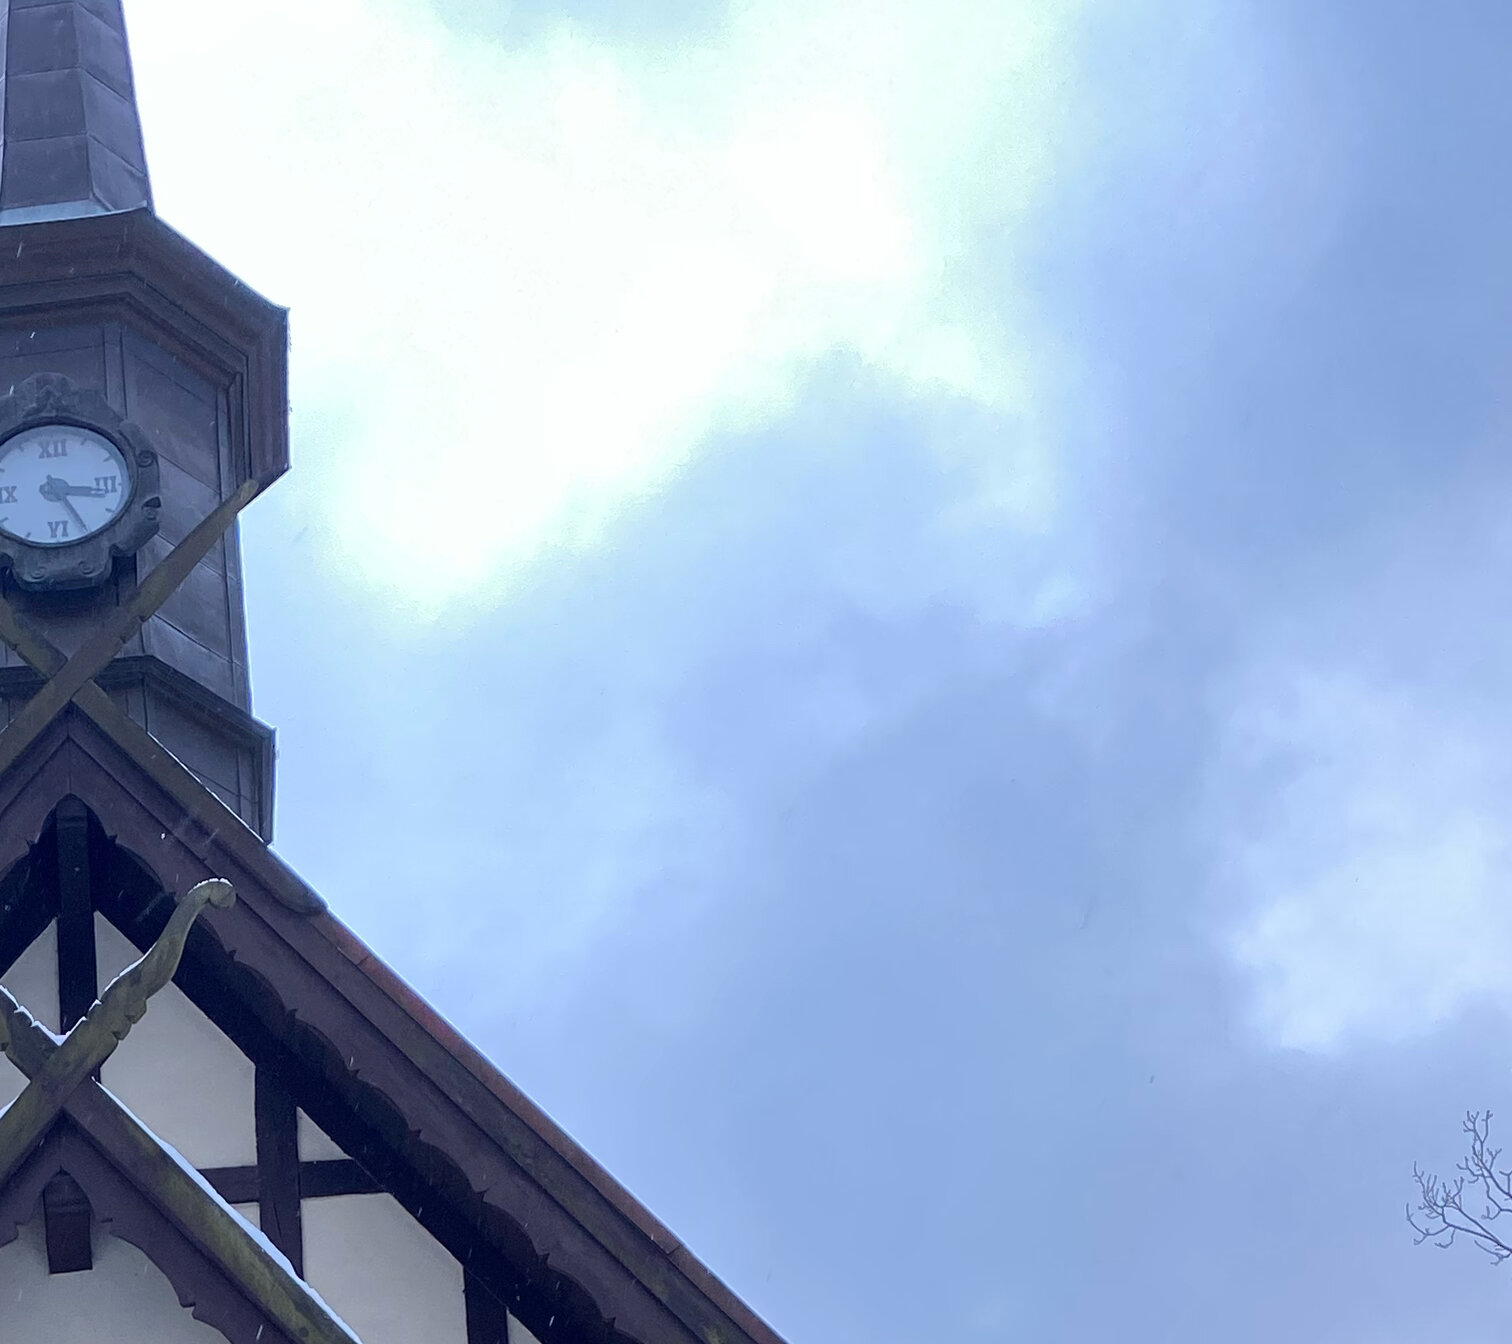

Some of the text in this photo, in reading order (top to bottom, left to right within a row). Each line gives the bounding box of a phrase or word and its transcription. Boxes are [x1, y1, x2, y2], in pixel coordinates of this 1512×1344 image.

[38, 438, 68, 459] XII
[94, 475, 118, 494] III
[47, 520, 69, 538] VI
